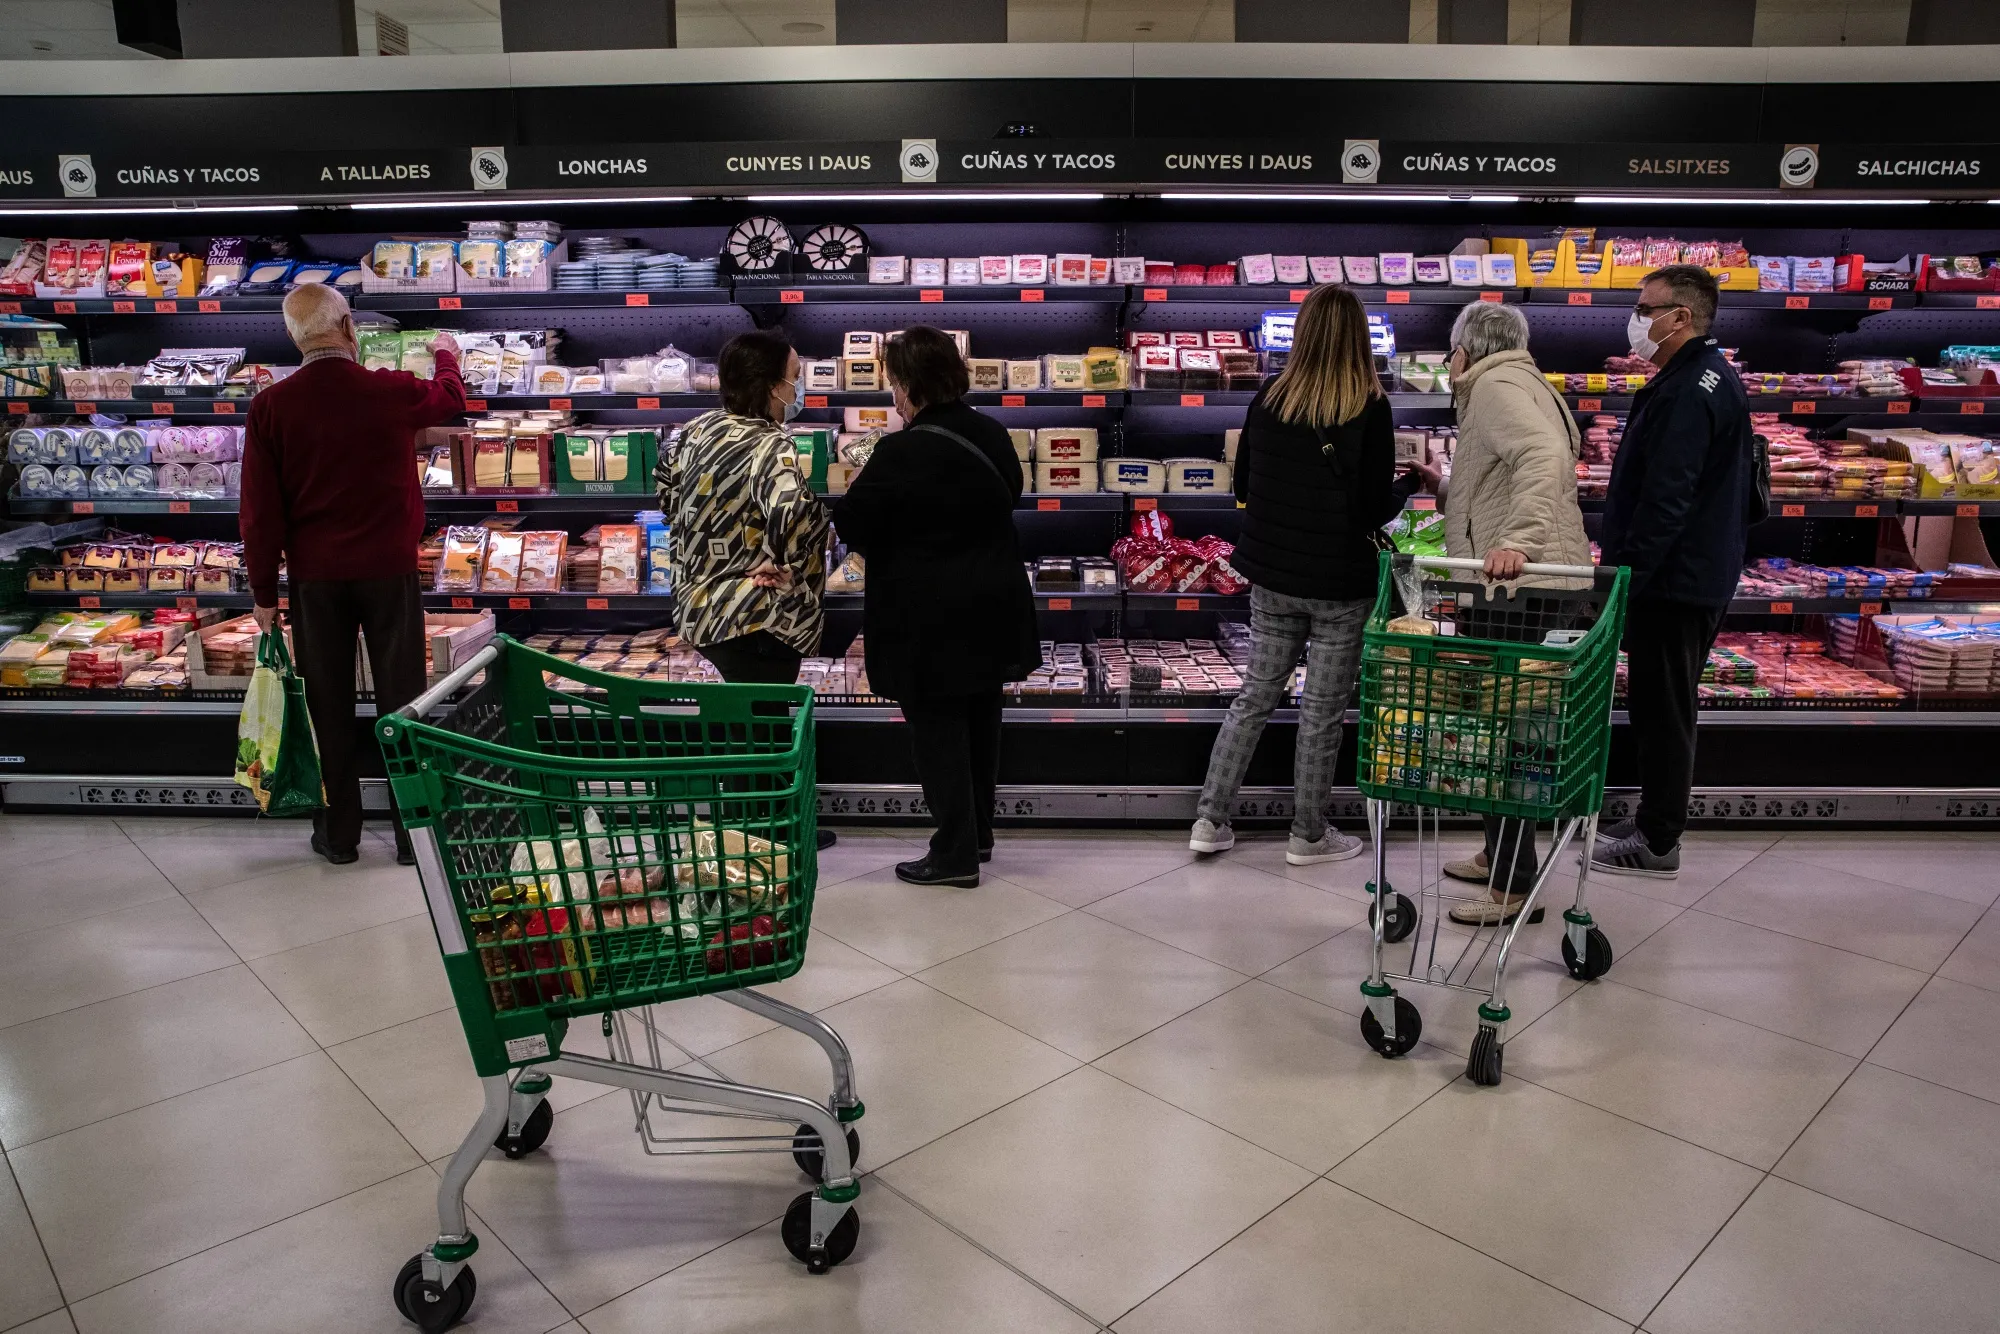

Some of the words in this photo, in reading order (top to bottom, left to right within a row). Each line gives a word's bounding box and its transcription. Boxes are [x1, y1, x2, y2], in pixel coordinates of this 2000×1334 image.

[558, 158, 648, 175] LONCHAS
[726, 156, 803, 172] CUNYES
[808, 156, 814, 171] I
[819, 155, 872, 171] DAUS
[961, 151, 1028, 170] CUÑAS
[1033, 155, 1047, 169] Y
[1051, 154, 1116, 169] TACOS
[1165, 154, 1243, 170] CUNYES
[1249, 154, 1254, 169] I
[1260, 154, 1313, 170] DAUS
[1402, 153, 1470, 172] CUÑAS
[1475, 157, 1489, 171] Y
[1493, 157, 1557, 173] TACOS
[1628, 158, 1730, 175] SALSITXES
[1857, 160, 1981, 176] SALCHICHAS
[117, 166, 179, 184] CUÑAS
[183, 168, 196, 183] Y
[200, 167, 260, 183] TACOS
[320, 166, 334, 181] A
[338, 164, 431, 181] TALLADES
[209, 244, 229, 258] Sin
[206, 256, 244, 266] lactosa
[1869, 281, 1909, 291] SCHARA
[1172, 558, 1193, 578] Curado
[1147, 572, 1169, 591] Curado
[1213, 572, 1236, 592] Curado
